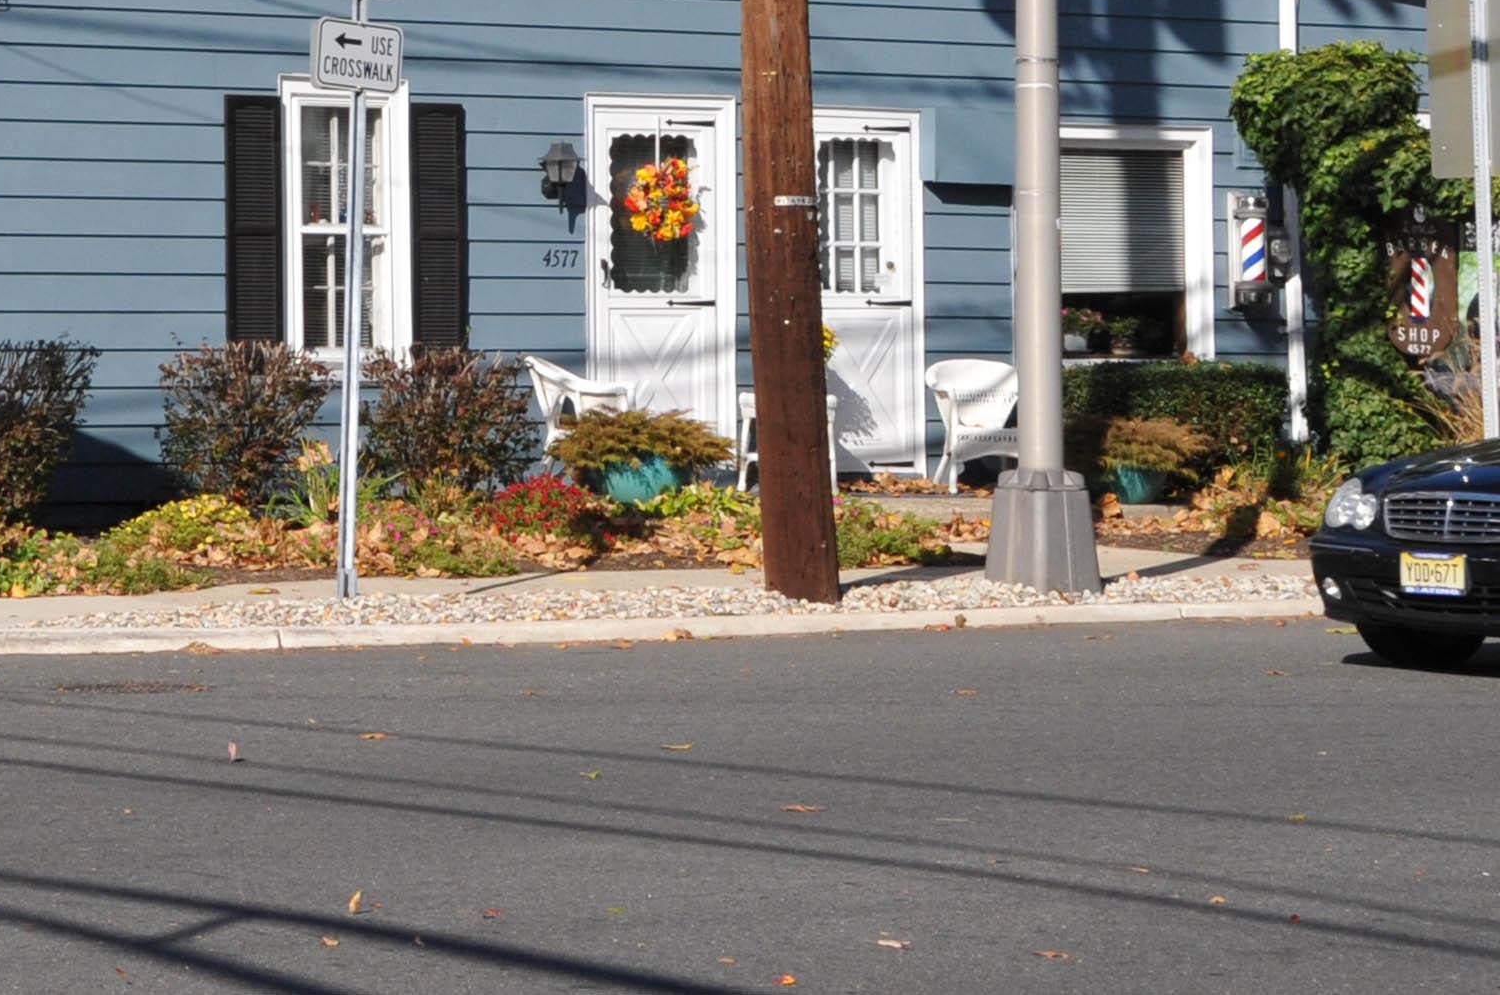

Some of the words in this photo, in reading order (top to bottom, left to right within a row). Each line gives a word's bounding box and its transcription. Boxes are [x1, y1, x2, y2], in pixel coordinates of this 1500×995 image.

[371, 36, 394, 57] USE
[323, 54, 394, 84] CROSSWALK
[542, 248, 579, 269] 4577
[1397, 326, 1440, 343] SHOP
[1407, 344, 1431, 354] 4577
